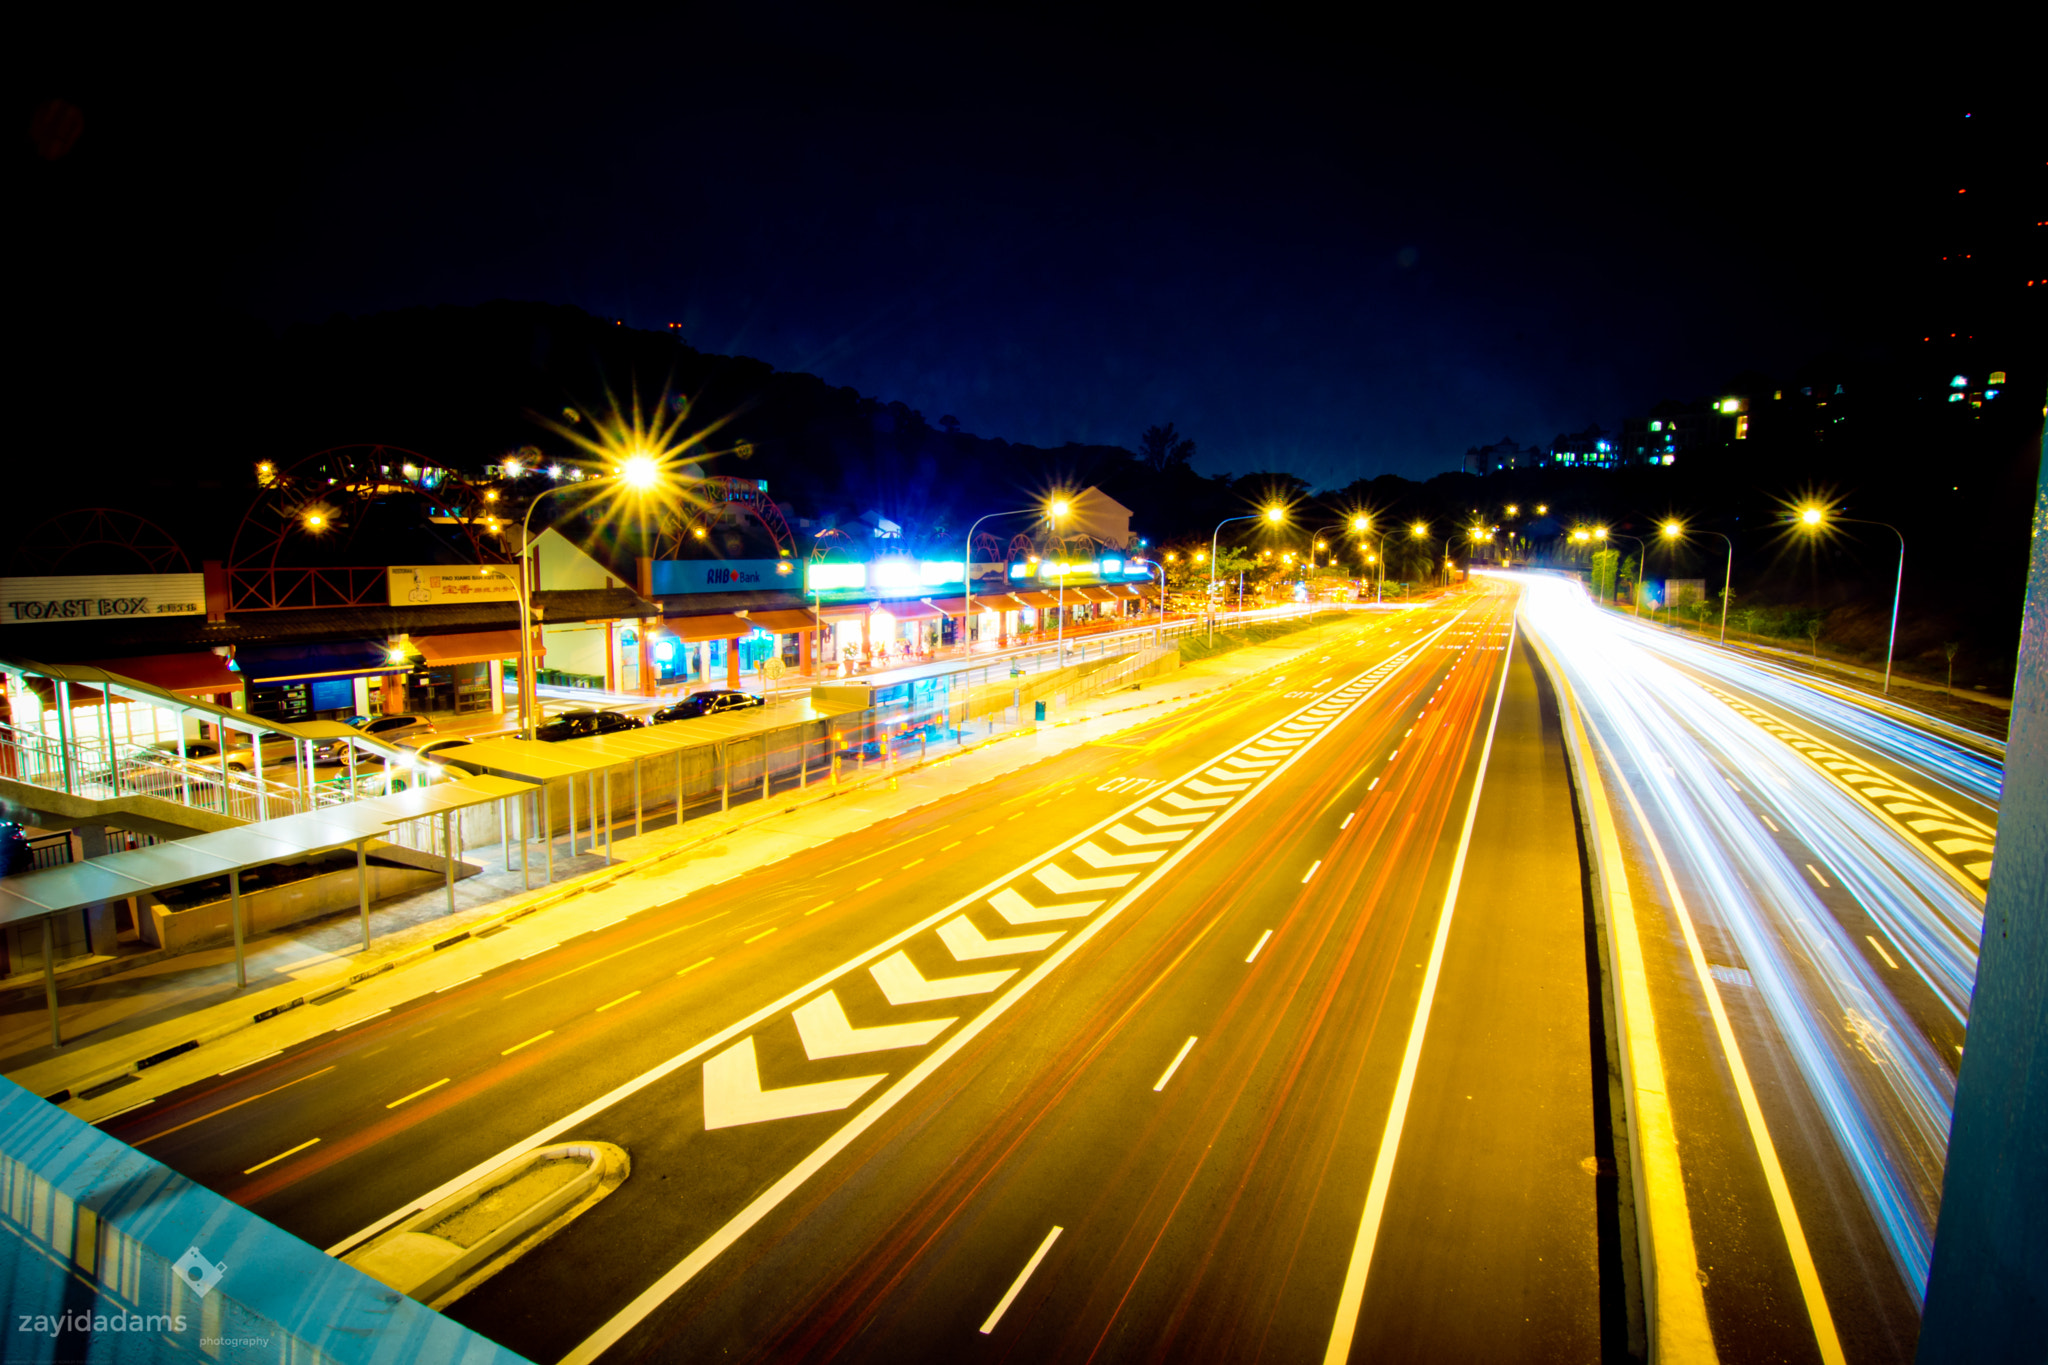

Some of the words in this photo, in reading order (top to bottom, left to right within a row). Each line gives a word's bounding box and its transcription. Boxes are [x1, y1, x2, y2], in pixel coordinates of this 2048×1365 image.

[707, 568, 730, 584] RHB
[740, 571, 760, 583] Bank
[8, 598, 95, 620] TOAST
[98, 596, 150, 616] BOX
[1283, 691, 1324, 699] CITY
[1096, 776, 1167, 795] CITY
